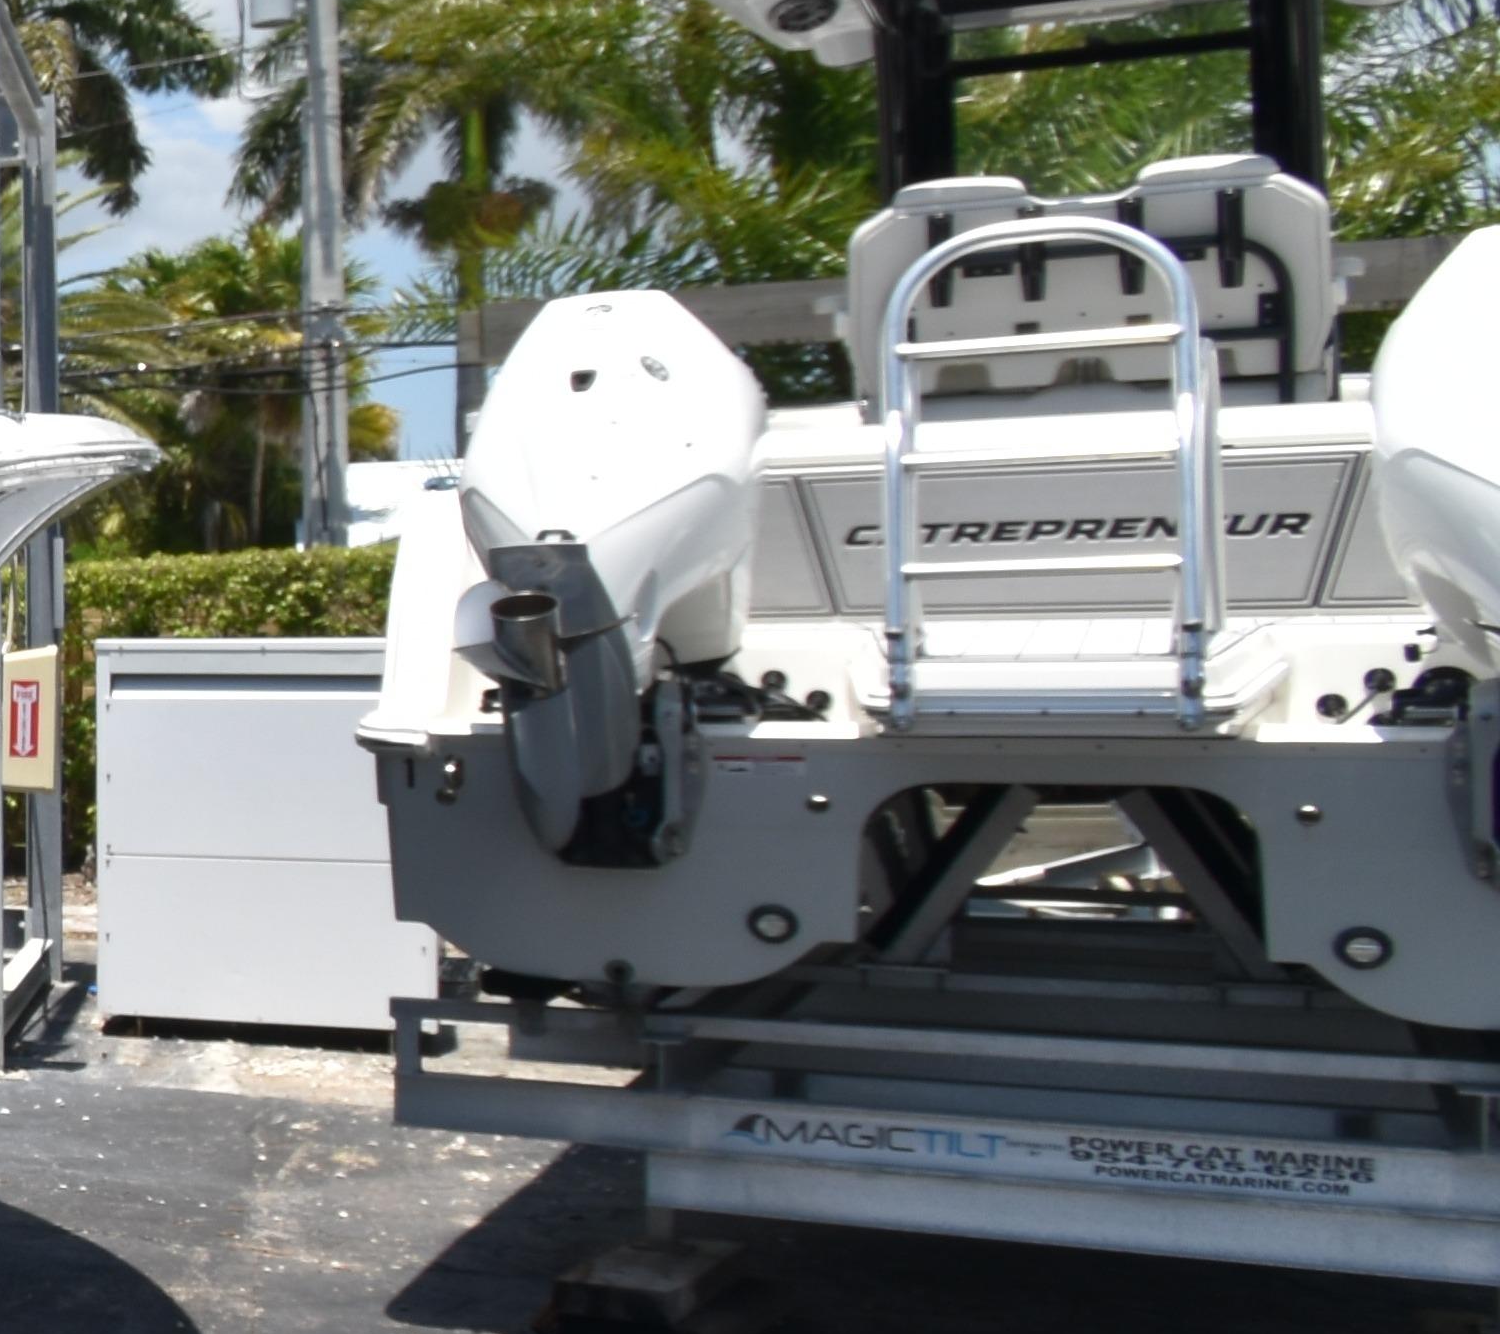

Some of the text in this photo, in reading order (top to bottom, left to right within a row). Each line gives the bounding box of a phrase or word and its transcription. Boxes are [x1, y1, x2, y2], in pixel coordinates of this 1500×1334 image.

[1069, 1135, 1174, 1159] POWER
[1185, 1144, 1243, 1163] CAT
[1254, 1148, 1376, 1174] MARINE
[1094, 1164, 1350, 1196] POWERCATMARINE.COM
